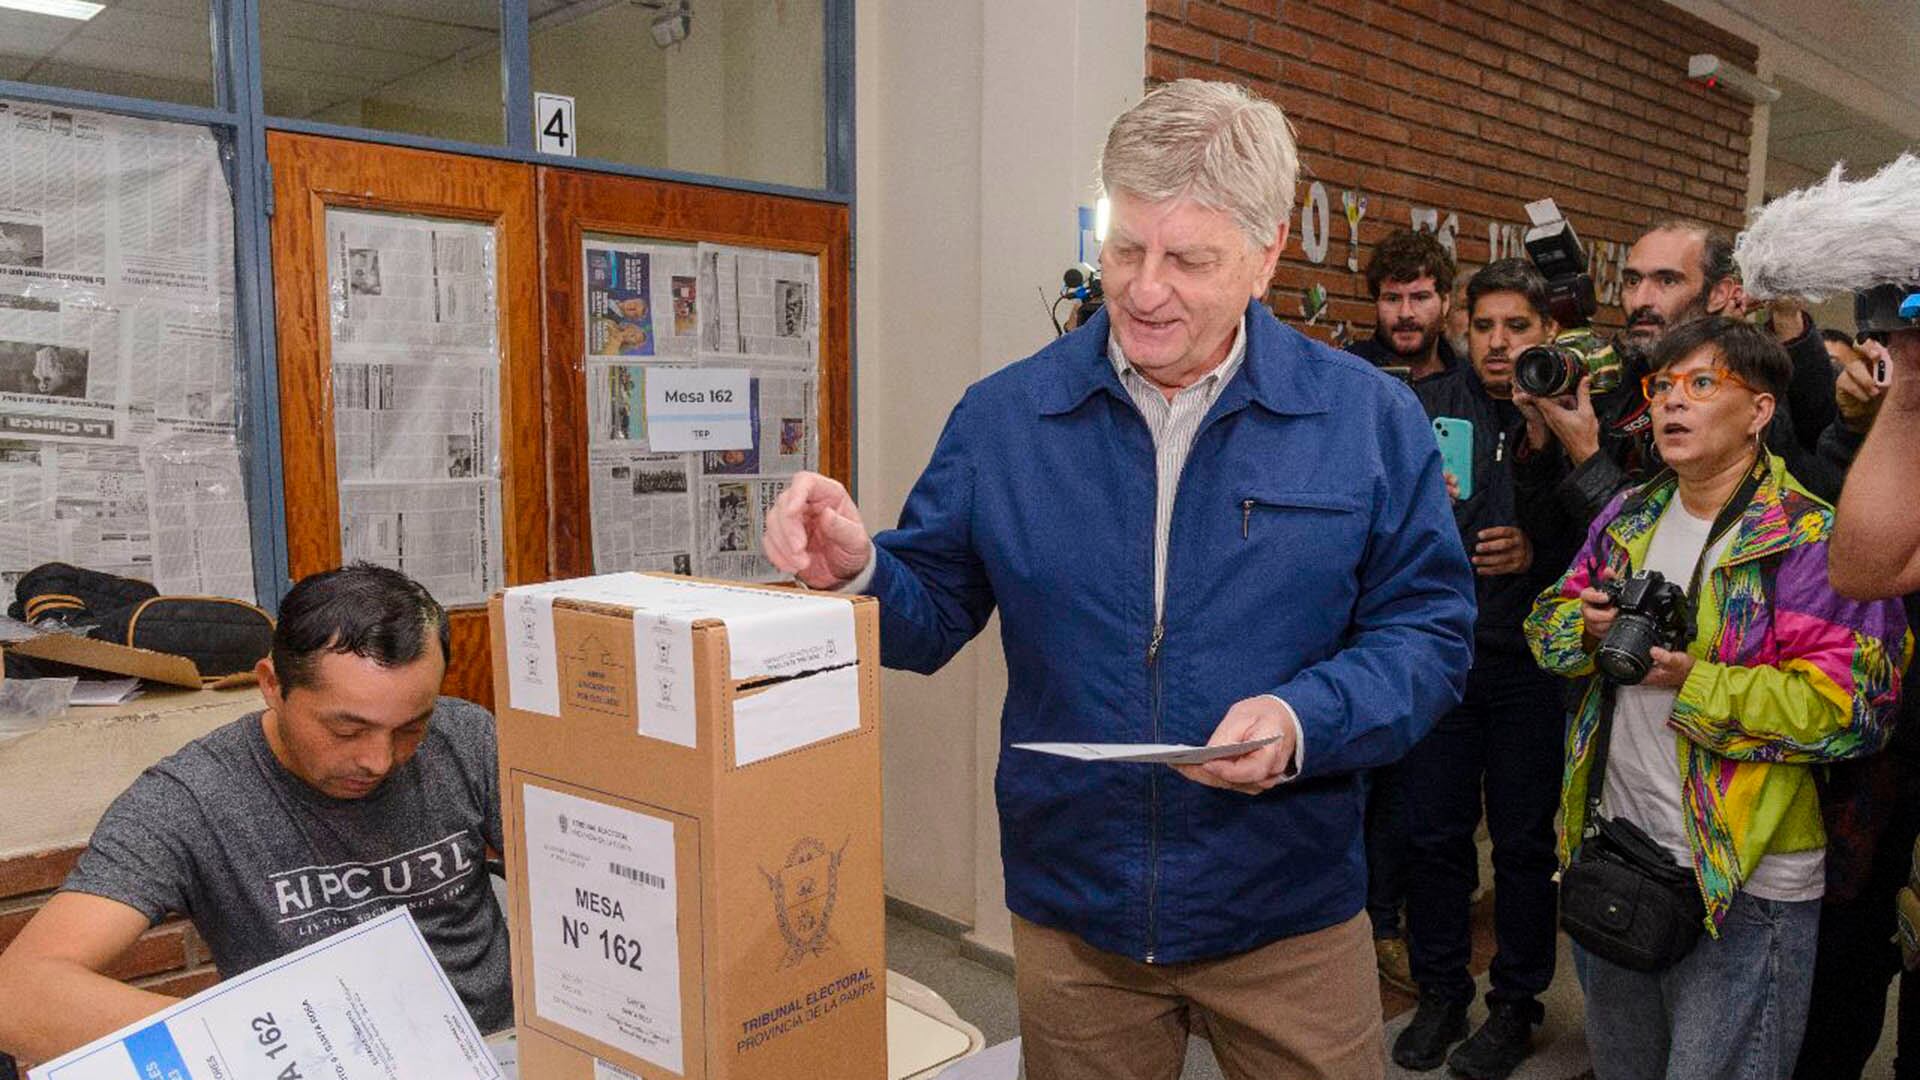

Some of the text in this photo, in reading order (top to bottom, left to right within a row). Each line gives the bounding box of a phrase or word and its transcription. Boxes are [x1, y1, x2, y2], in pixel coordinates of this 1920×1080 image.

[543, 107, 569, 147] 4
[665, 390, 733, 403] Mesa 162
[1623, 414, 1650, 432] EOS
[575, 887, 624, 922] MESA
[599, 929, 643, 971] 162
[302, 999, 318, 1024] ROSA
[736, 981, 876, 1054] PROVINCIA DE LA PAMPA
[742, 967, 873, 1034] TRIBUNAL ELECTORAL
[251, 1012, 287, 1060] 162
[315, 1024, 333, 1053] SANTA
[205, 1055, 225, 1080] ORES
